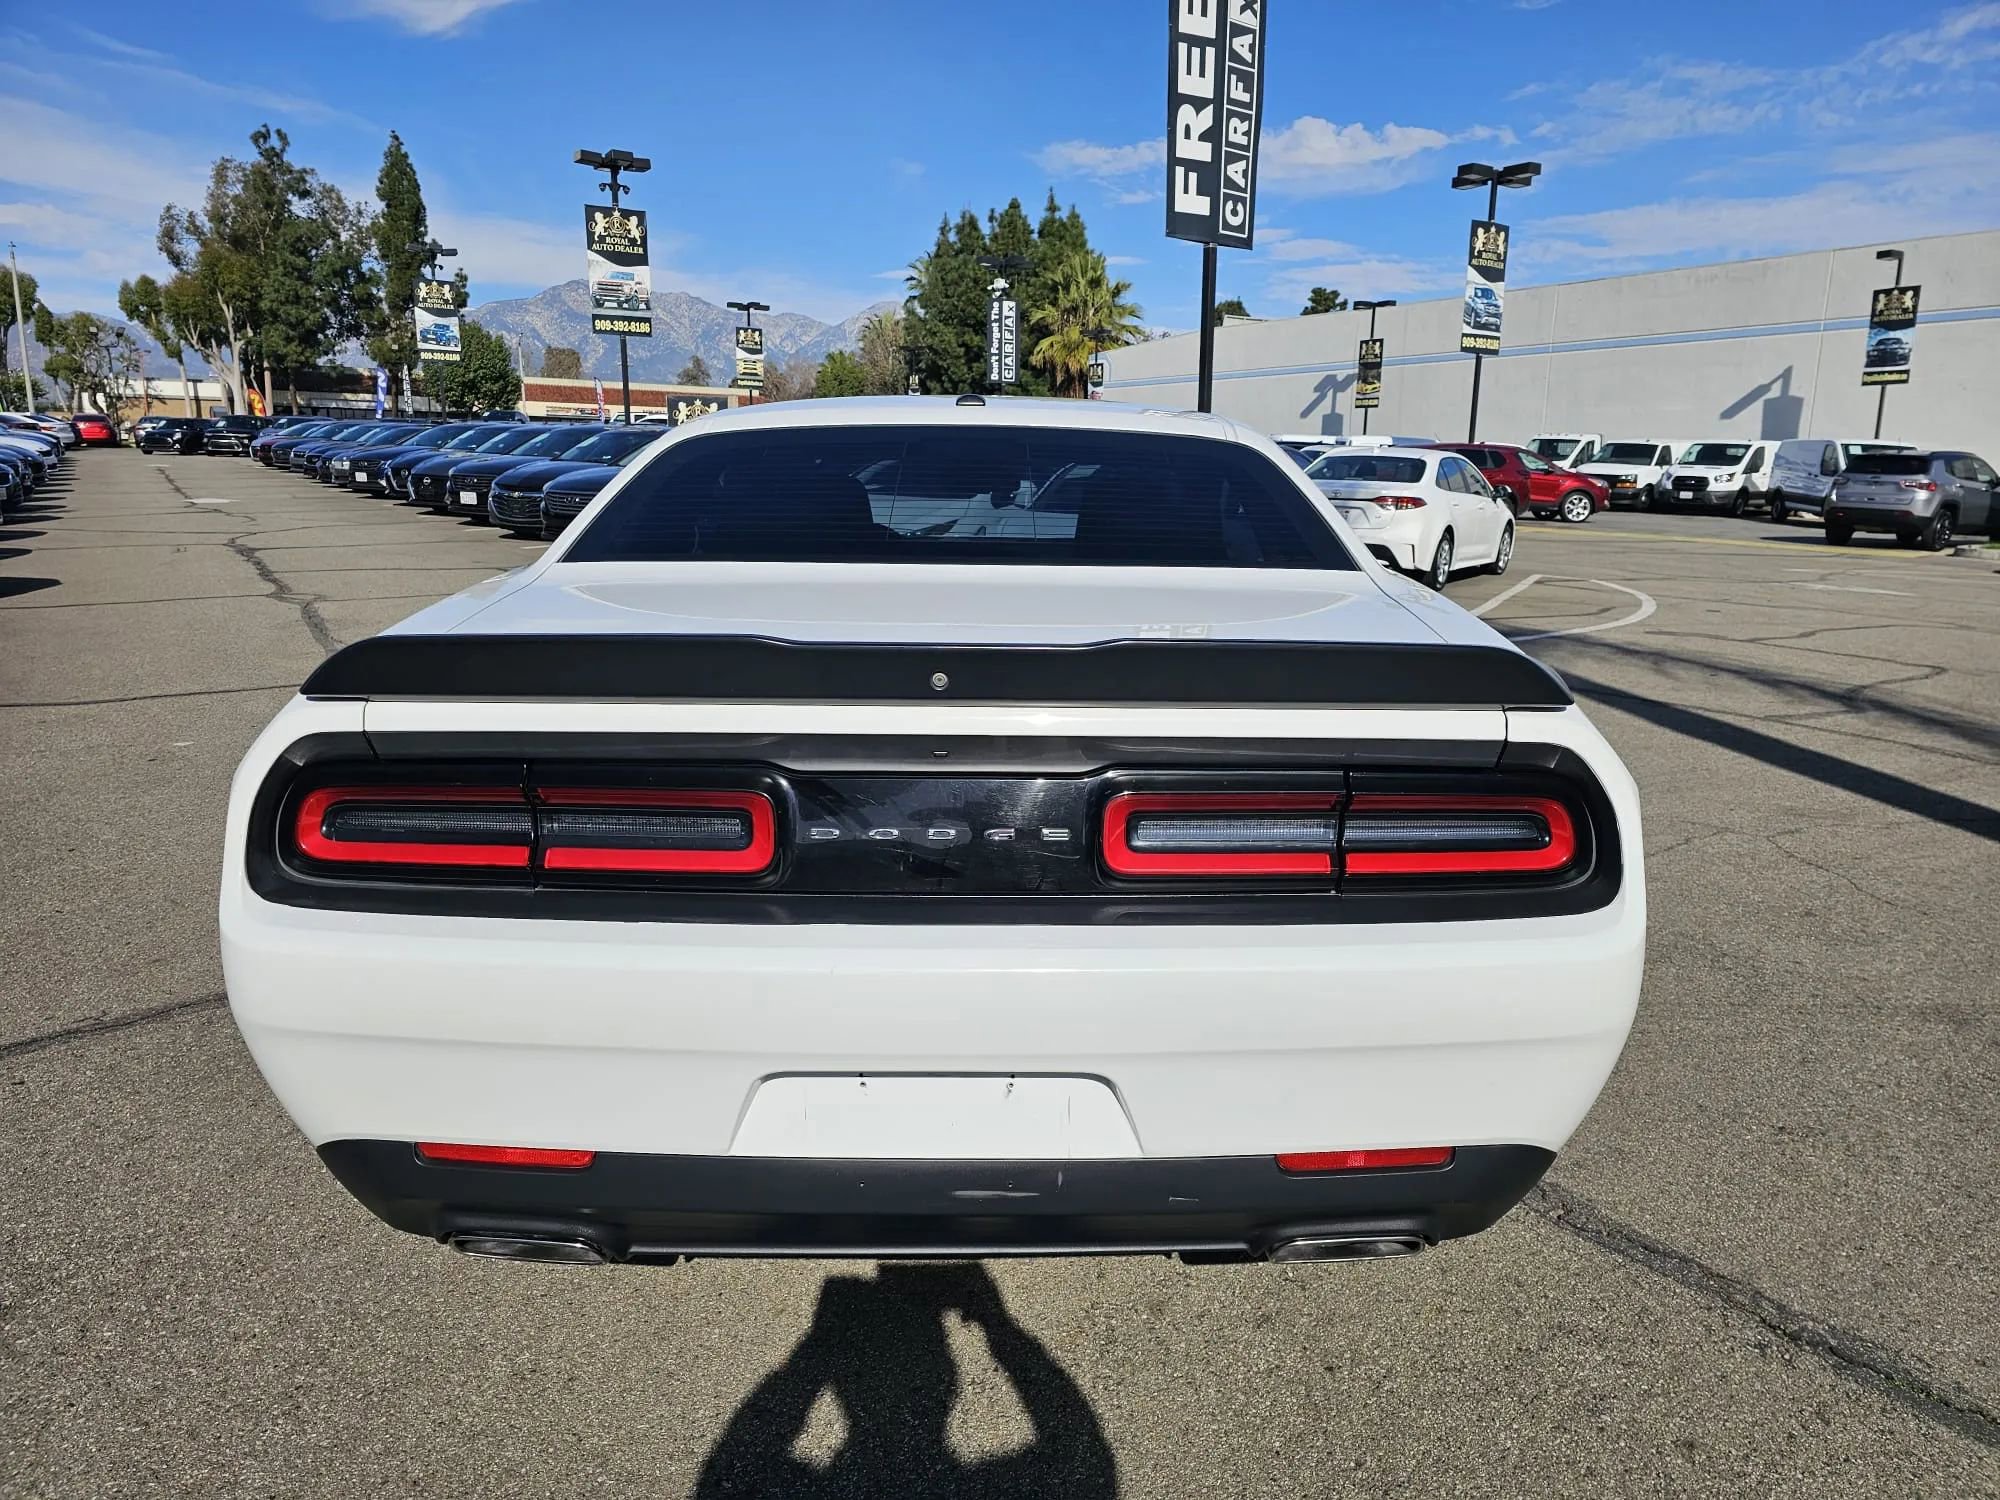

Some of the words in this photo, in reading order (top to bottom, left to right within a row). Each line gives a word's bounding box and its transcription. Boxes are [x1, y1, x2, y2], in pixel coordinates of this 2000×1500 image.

[1174, 0, 1217, 216] FREE
[1225, 0, 1257, 226] CARFAX
[592, 243, 614, 252] AUTO
[615, 244, 644, 254] DEALER
[605, 236, 630, 246] ROYAL
[990, 301, 1000, 320] The
[594, 319, 651, 333] 909-392-8186
[990, 322, 1000, 354] Forget
[1004, 305, 1015, 379] CARFAX
[990, 355, 999, 380] Don't
[809, 827, 1070, 841] DODGE
